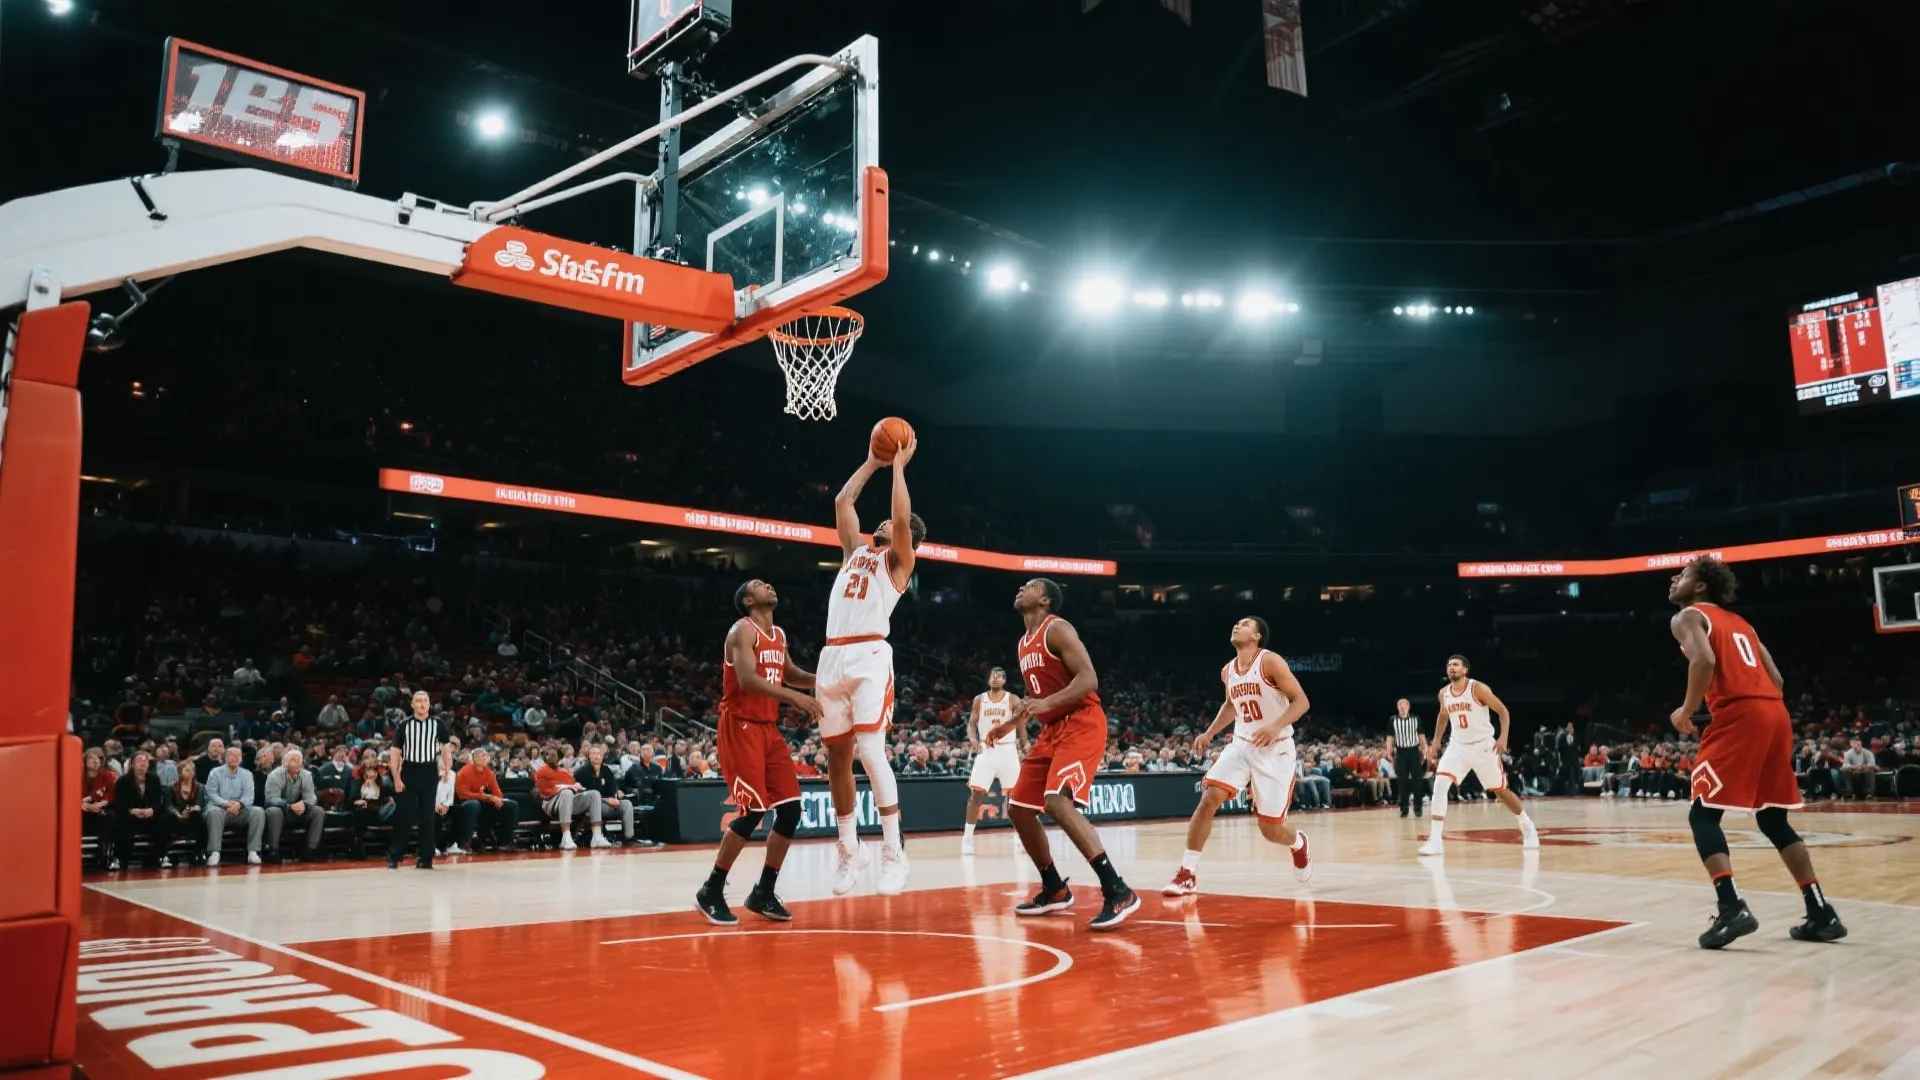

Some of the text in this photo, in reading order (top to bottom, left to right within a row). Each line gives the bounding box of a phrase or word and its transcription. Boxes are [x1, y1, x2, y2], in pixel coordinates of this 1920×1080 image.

[843, 573, 869, 600] 21
[1732, 632, 1757, 668] 0
[1030, 673, 1041, 695] 0
[1240, 699, 1263, 723] 20
